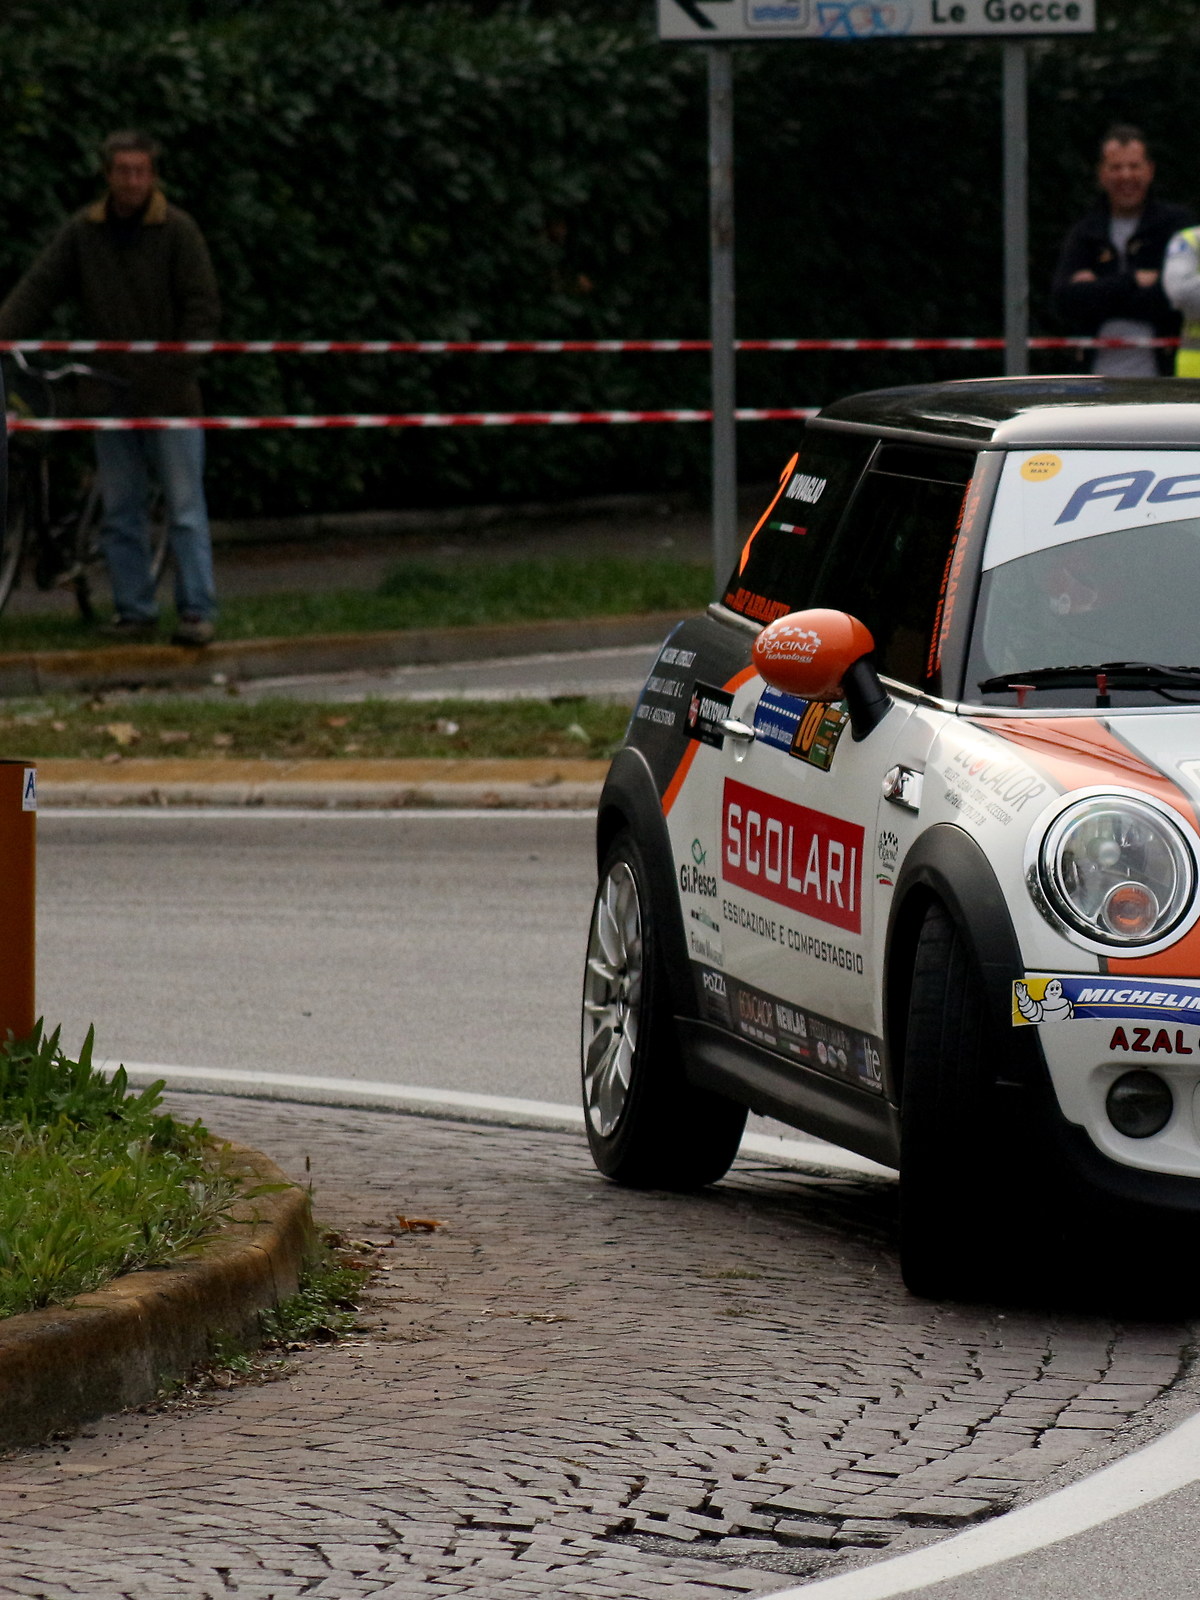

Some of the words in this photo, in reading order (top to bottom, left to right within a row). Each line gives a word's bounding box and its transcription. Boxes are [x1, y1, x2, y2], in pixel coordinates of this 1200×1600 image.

[930, 0, 966, 24] Le
[983, 0, 1082, 23] Gocce
[726, 802, 857, 912] SCOLARI
[779, 926, 786, 946] E
[787, 928, 864, 976] COMPOSTAGGIO
[1109, 1026, 1193, 1055] AZAL
